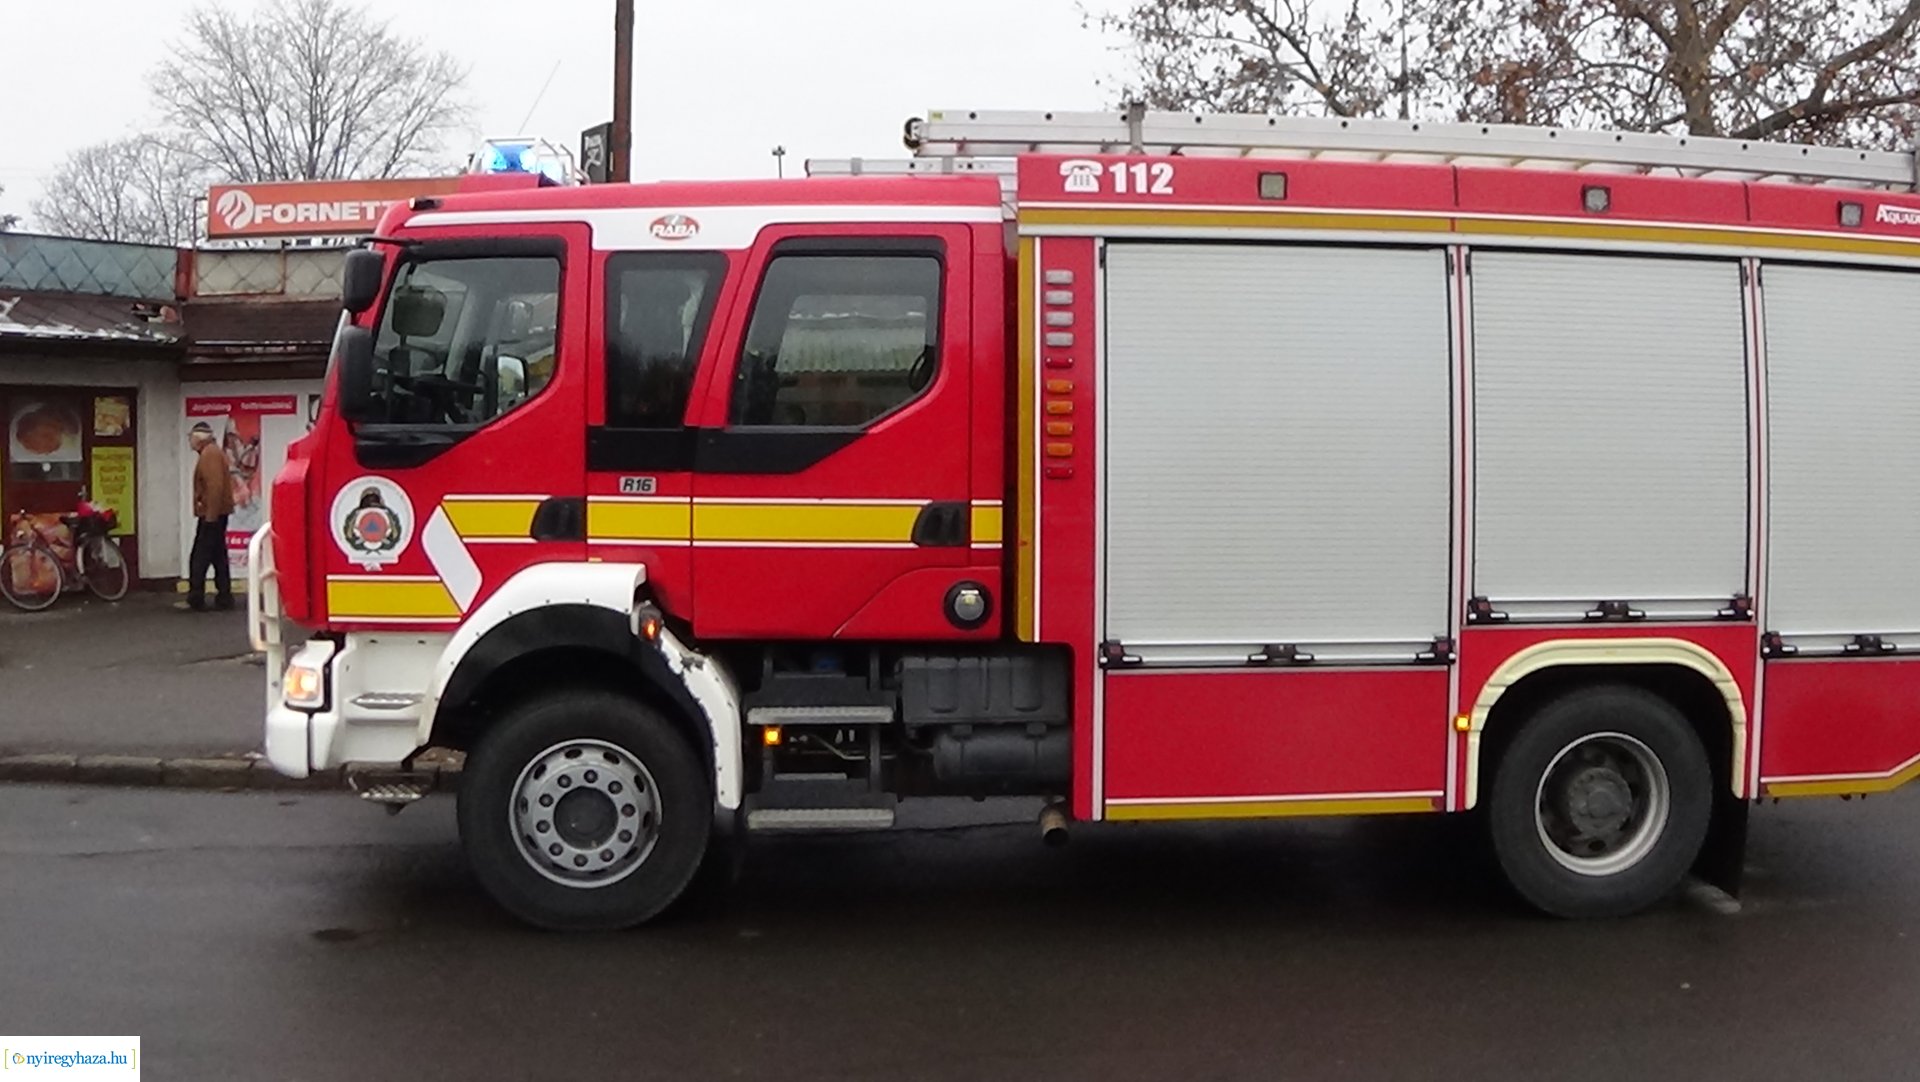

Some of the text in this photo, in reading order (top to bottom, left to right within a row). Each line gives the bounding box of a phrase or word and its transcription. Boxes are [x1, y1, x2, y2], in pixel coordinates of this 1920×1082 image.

[1109, 161, 1174, 194] 112
[1875, 204, 1920, 225] AQUAD
[623, 478, 652, 492] R16
